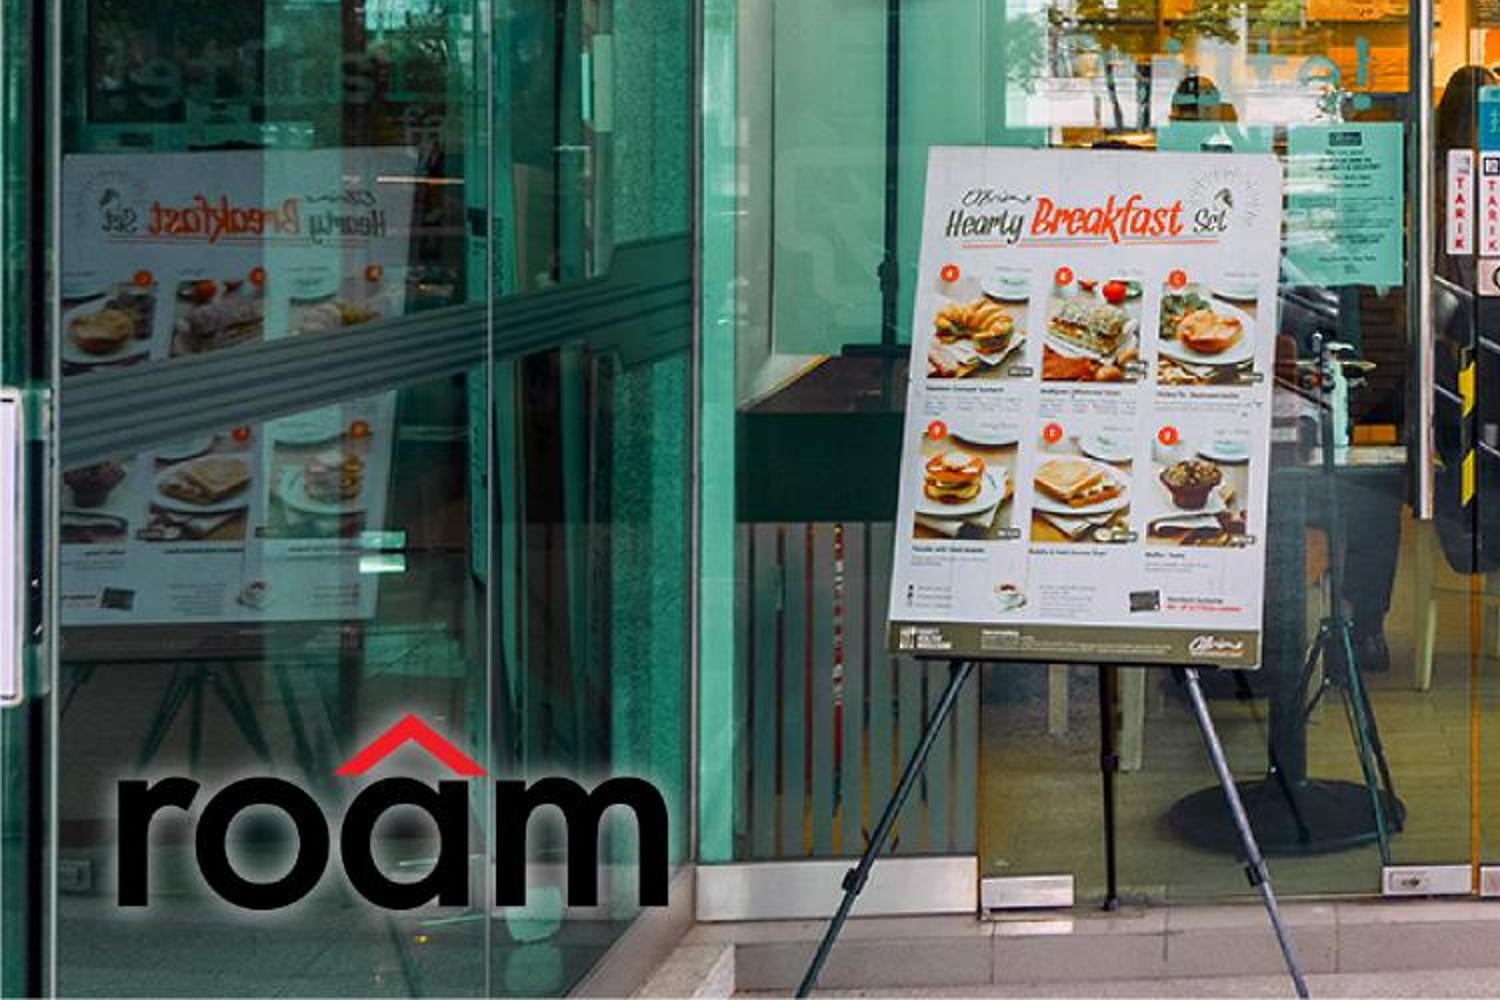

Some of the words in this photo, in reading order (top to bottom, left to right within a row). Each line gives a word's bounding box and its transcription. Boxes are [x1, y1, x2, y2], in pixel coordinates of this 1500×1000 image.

[945, 209, 1024, 245] Hearty
[1031, 194, 1185, 243] Breakfast
[1455, 177, 1465, 249] TARIK
[1488, 181, 1497, 250] TARIK
